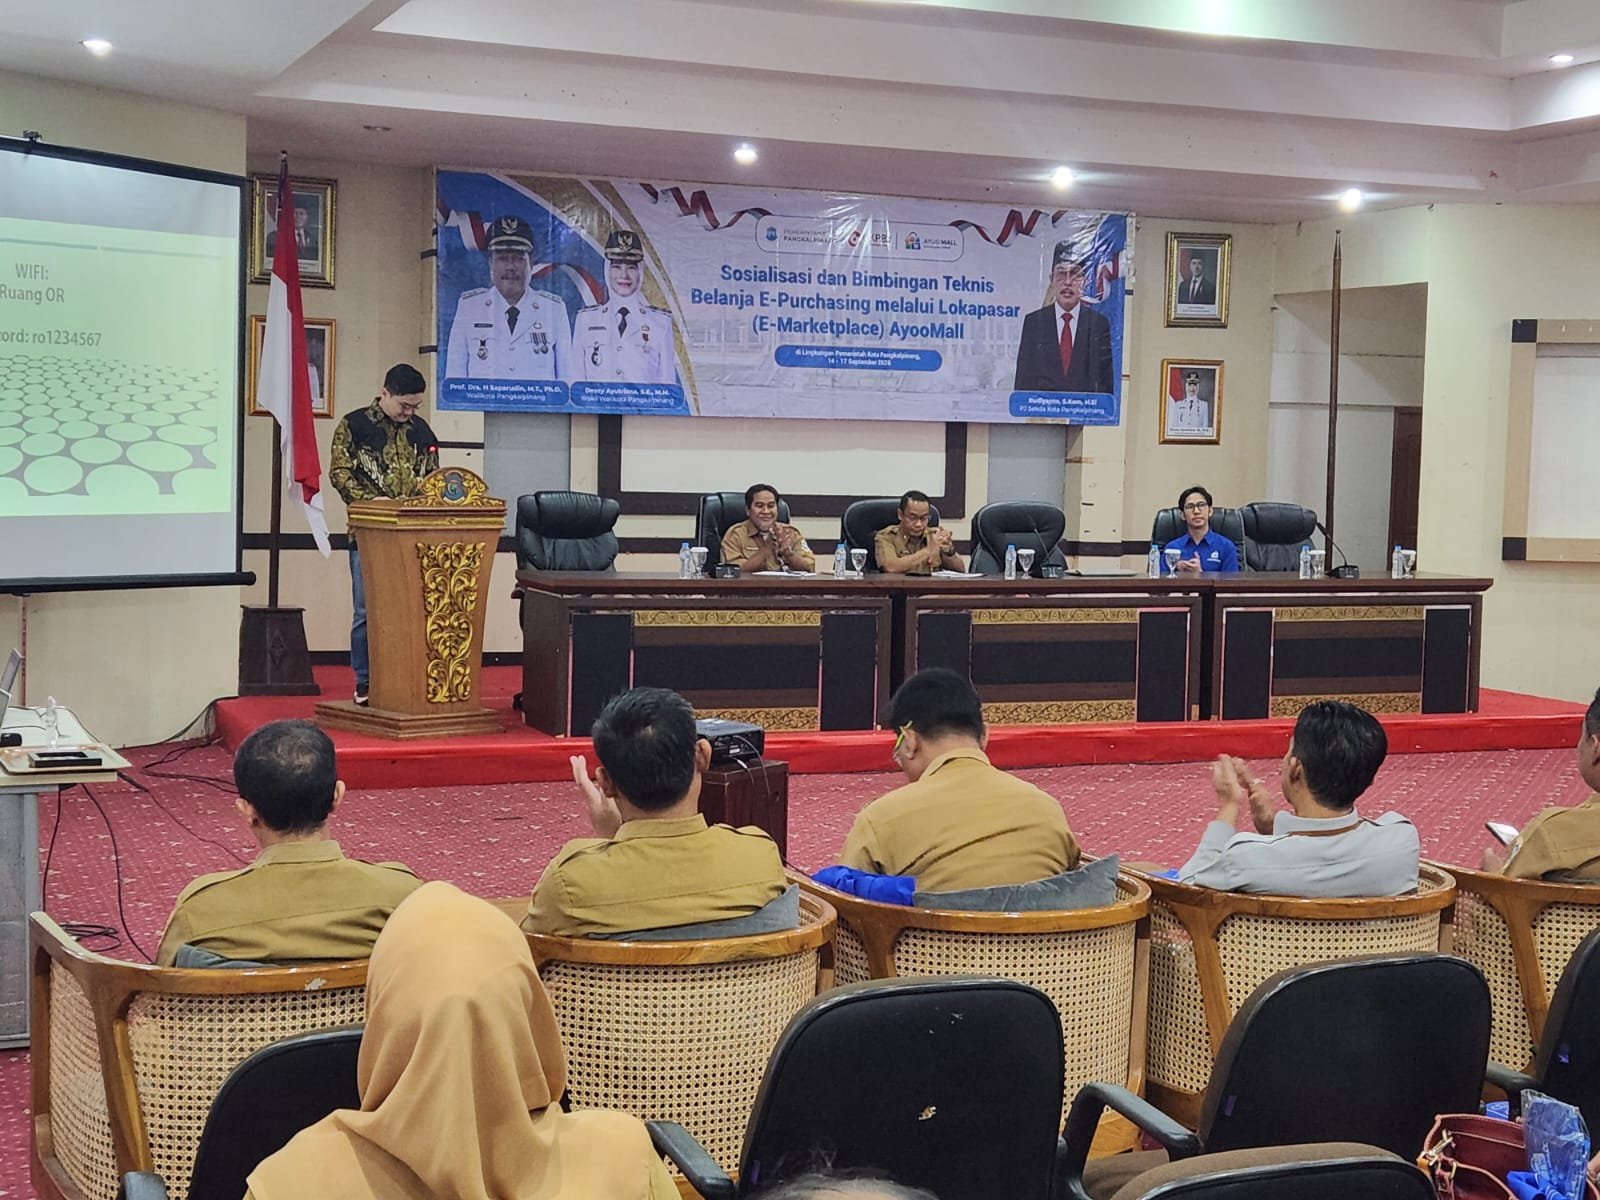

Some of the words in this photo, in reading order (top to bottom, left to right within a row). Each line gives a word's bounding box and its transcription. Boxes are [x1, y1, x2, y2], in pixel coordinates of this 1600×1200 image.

[15, 262, 49, 281] WIFI:
[720, 264, 812, 285] Sosialisasi
[817, 268, 847, 286] dan
[852, 270, 938, 293] Bimbingan
[943, 275, 995, 293] Teknis
[0, 283, 42, 305] Ruang
[46, 287, 65, 303] OR
[691, 287, 755, 310] Belanja
[760, 291, 870, 315] E-Purchasing
[875, 297, 934, 314] melalui
[938, 298, 1021, 320] Lokapasar
[0, 328, 29, 343] ord:
[32, 329, 102, 347] ro1234567
[752, 314, 885, 340] (E-Marketplace)
[889, 321, 964, 340] AyooMall
[449, 383, 466, 391] Prof.
